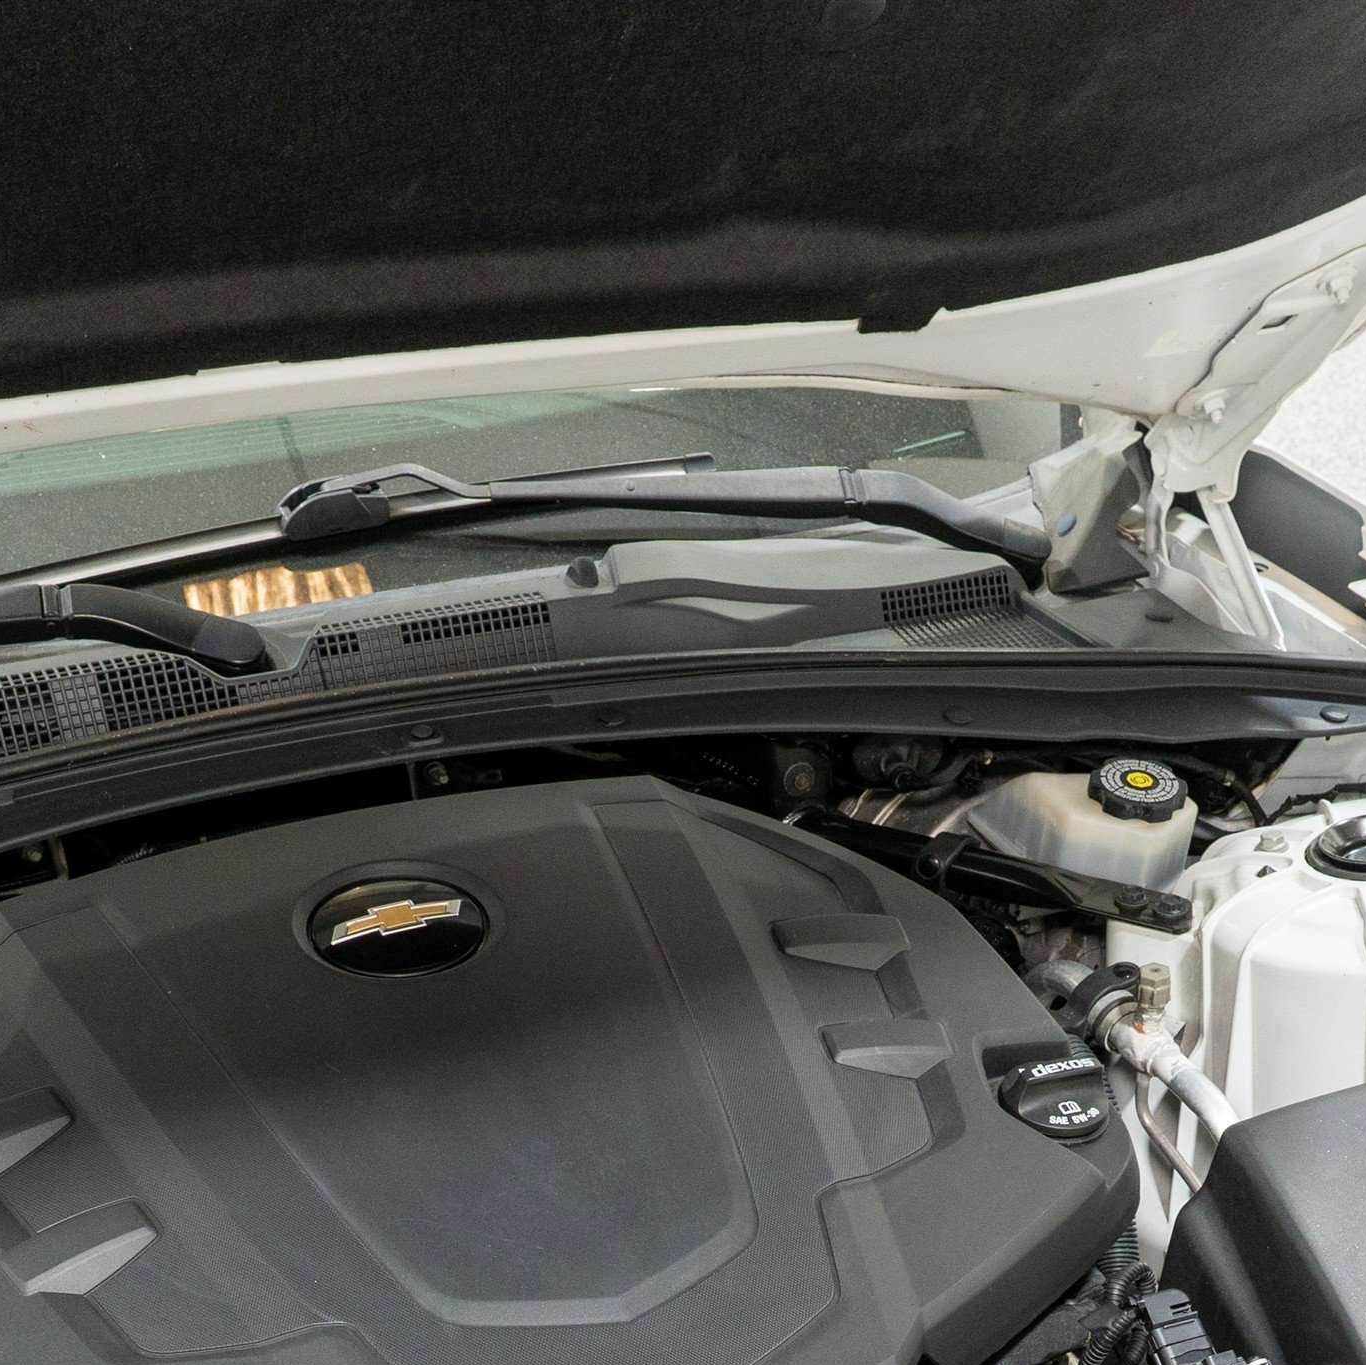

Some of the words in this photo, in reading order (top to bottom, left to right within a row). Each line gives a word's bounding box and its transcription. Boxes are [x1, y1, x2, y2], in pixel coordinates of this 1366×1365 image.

[1031, 1058, 1095, 1077] dexos
[1049, 1115, 1069, 1125] SAE
[1072, 1107, 1100, 1124] 5W-30
